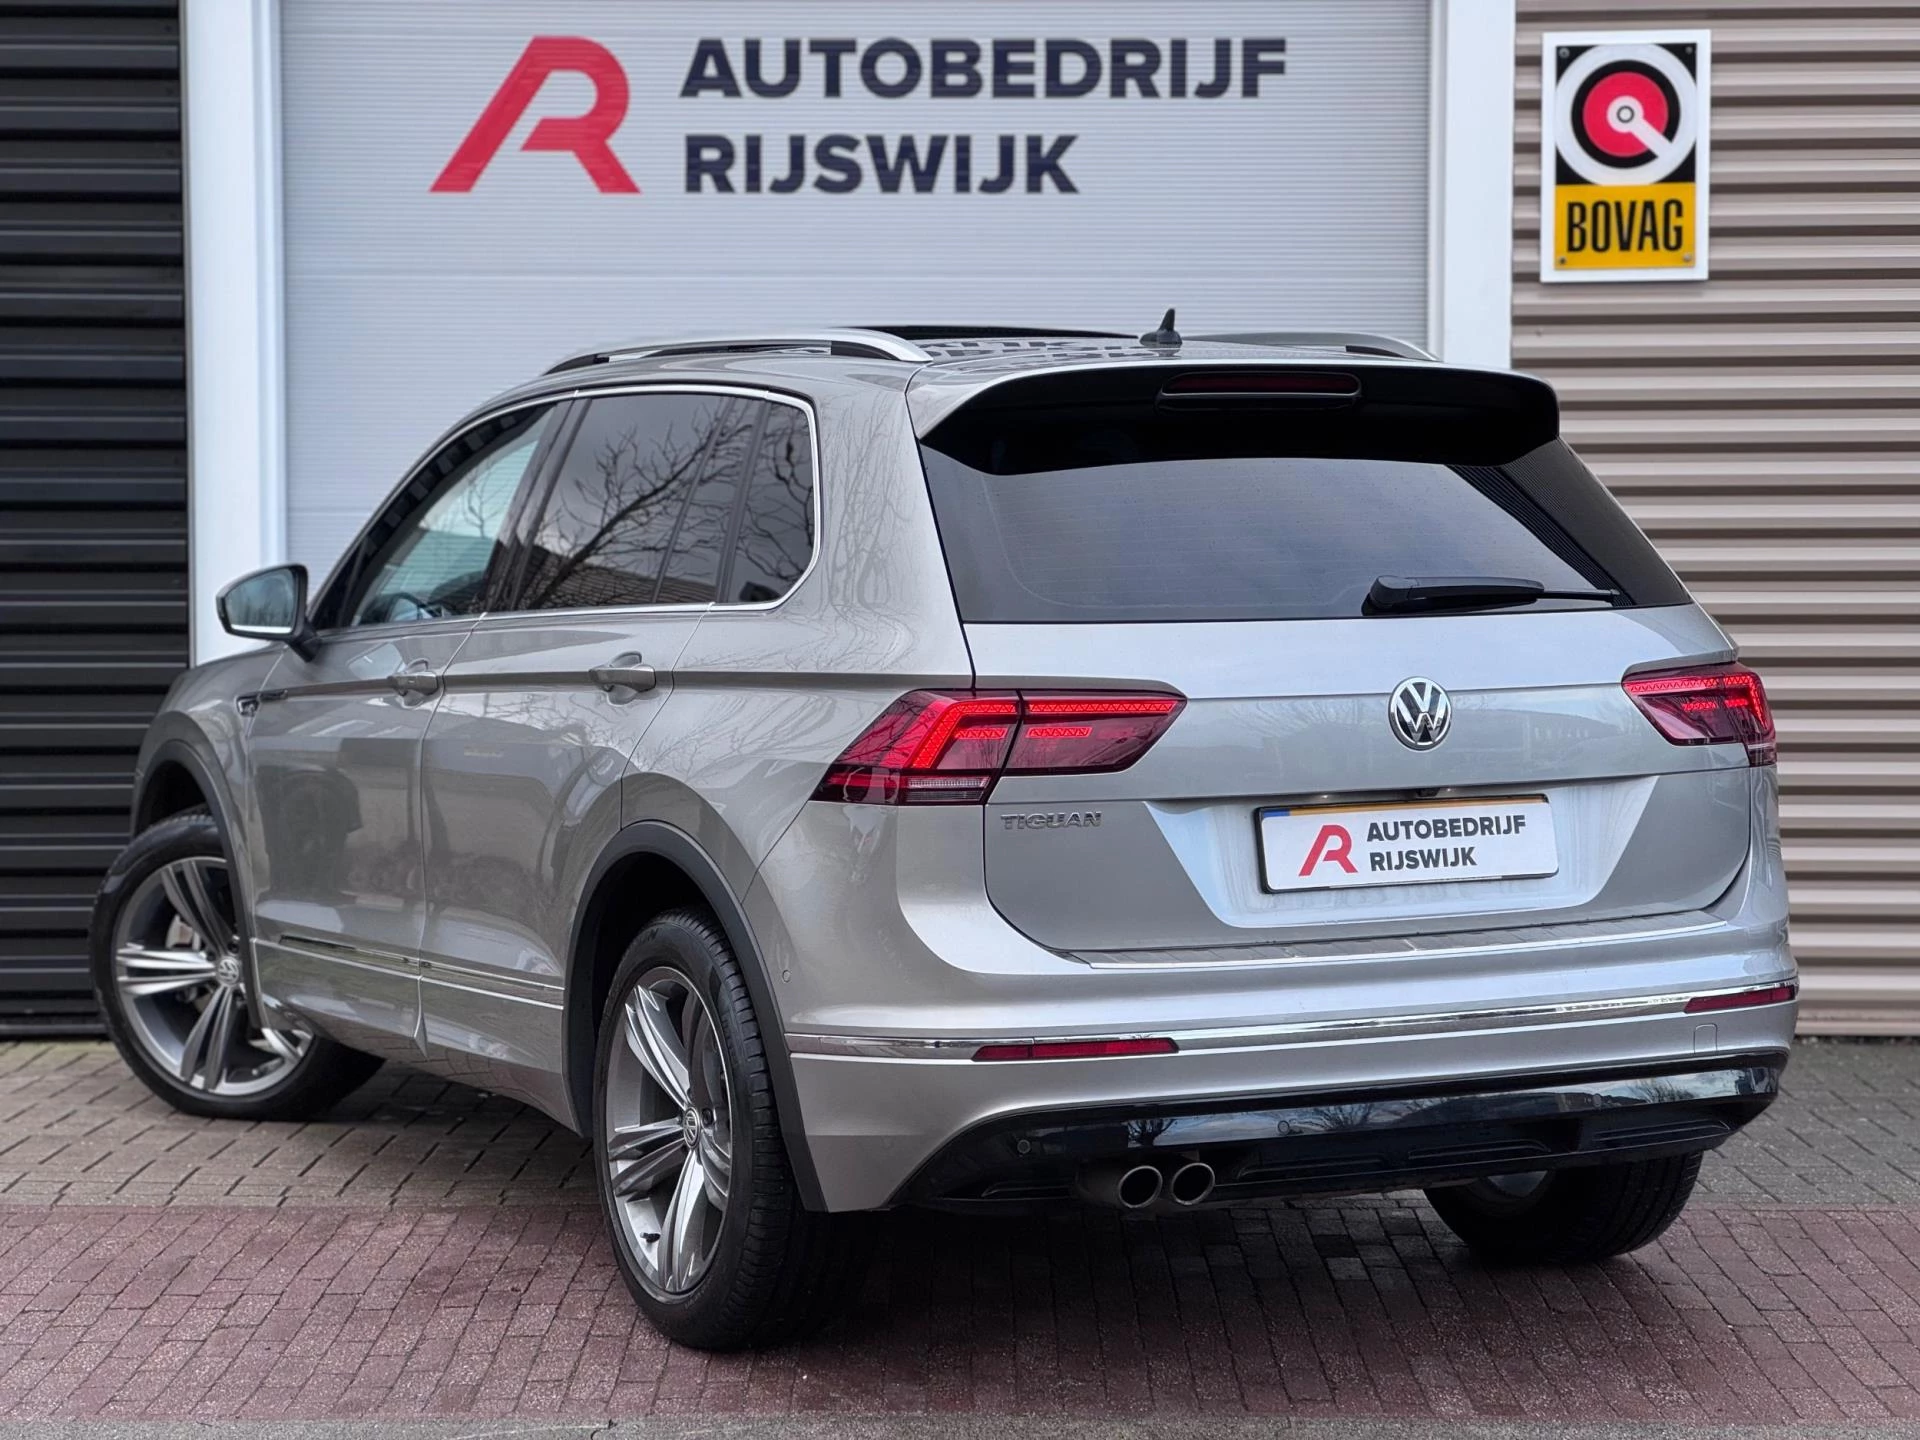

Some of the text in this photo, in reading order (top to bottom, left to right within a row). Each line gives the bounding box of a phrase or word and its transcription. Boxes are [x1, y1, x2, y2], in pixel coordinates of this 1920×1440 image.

[680, 37, 1287, 98] AUTOBEDRIJF
[685, 134, 1079, 194] RIJSWIJK
[1566, 198, 1684, 253] BOVAG
[1000, 811, 1102, 830] TIGUAN
[1366, 814, 1526, 842] AUTOBEDRIJF
[1369, 846, 1478, 872] RIJSWIJK
